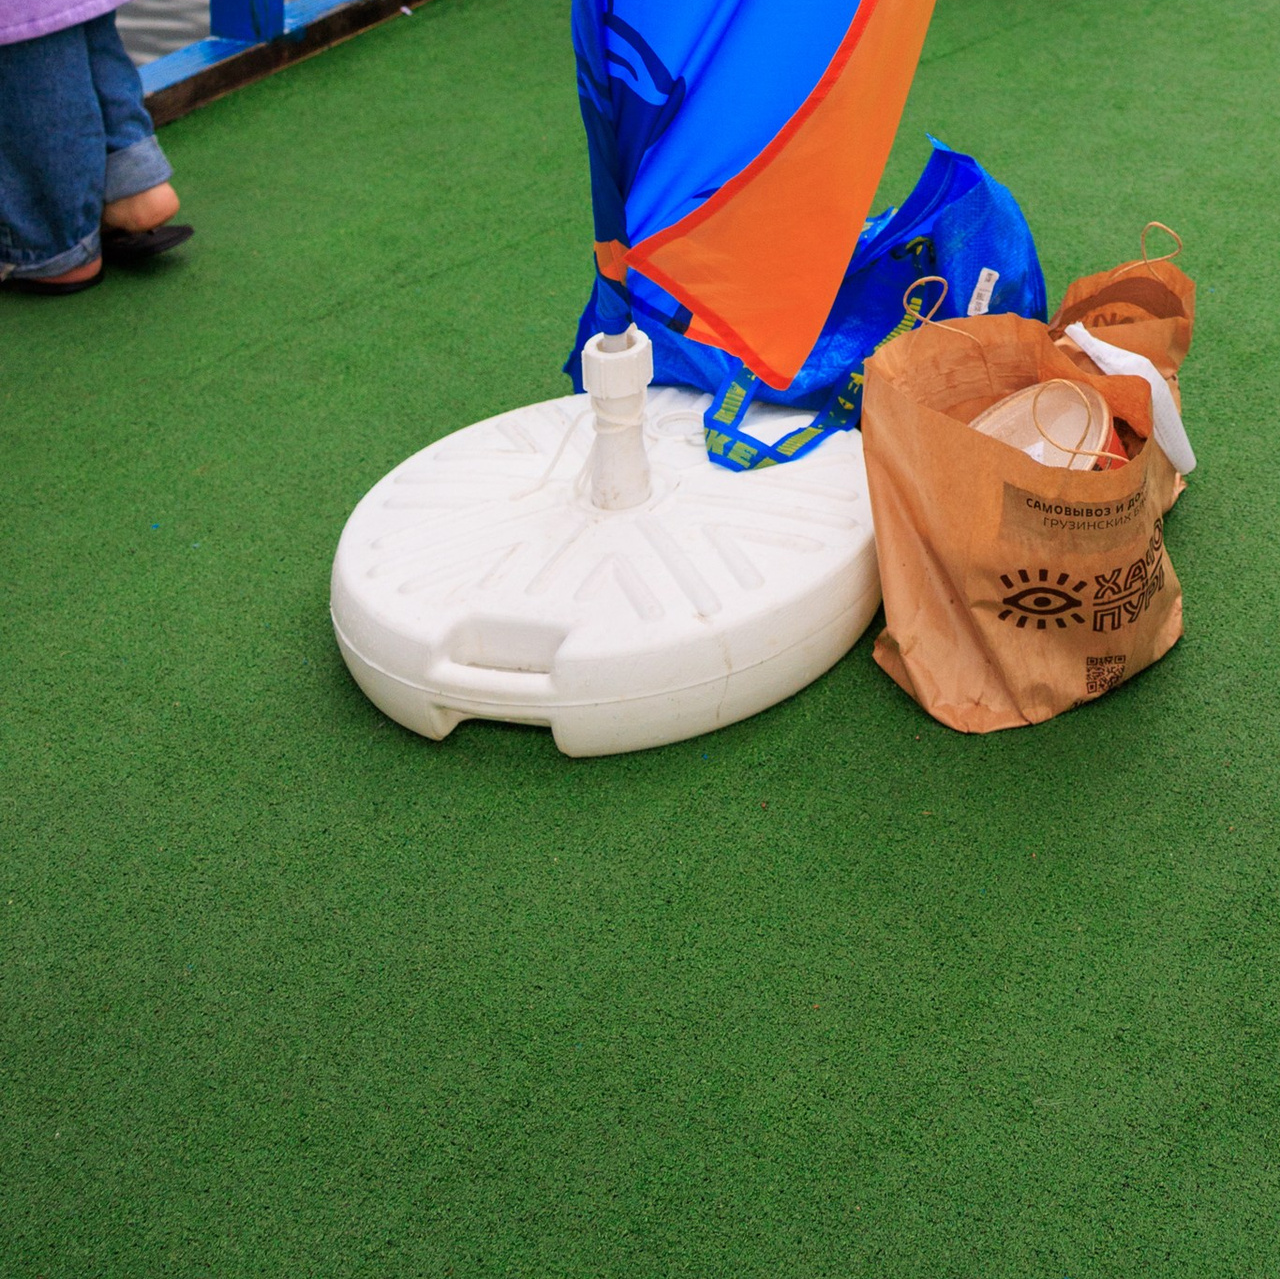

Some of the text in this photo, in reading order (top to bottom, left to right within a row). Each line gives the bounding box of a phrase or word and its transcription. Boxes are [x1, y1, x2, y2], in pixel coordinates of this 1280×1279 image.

[1026, 498, 1111, 517] САМОВЫВОЗ
[1116, 503, 1124, 514] И
[1043, 513, 1131, 530] ГРУЗИНСКИХ
